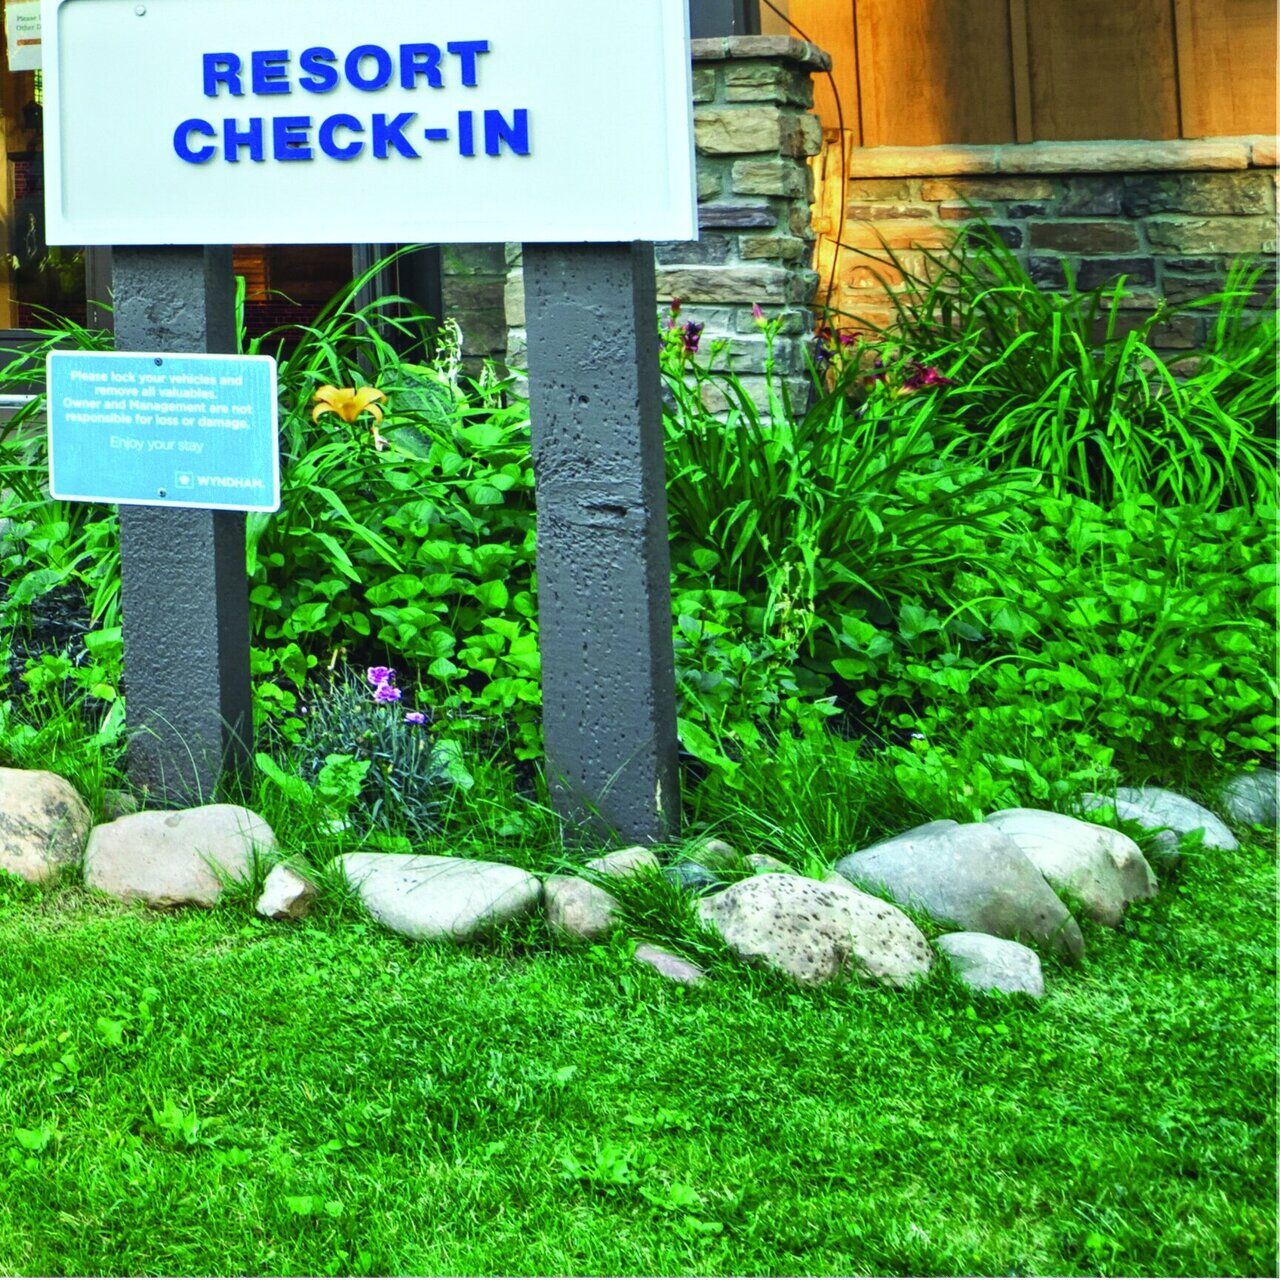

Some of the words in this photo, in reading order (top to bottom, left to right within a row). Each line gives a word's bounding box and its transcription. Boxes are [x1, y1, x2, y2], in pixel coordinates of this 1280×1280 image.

[203, 40, 493, 97] RESORT
[173, 108, 532, 163] CHECK-IN
[71, 370, 108, 381] Please
[110, 371, 136, 382] lock
[139, 374, 165, 384] your
[169, 373, 217, 385] vehicles
[219, 375, 243, 386] and
[95, 387, 138, 396] remove
[141, 386, 156, 397] all
[159, 387, 218, 400] valuables.
[63, 397, 101, 409] Owner
[104, 399, 127, 410] and
[129, 400, 207, 413] Management
[209, 405, 229, 414] are
[231, 404, 252, 415] not
[65, 413, 132, 425] responsible
[135, 414, 153, 424] for
[155, 414, 179, 426] loss
[181, 417, 195, 426] or
[197, 416, 249, 431] damage.
[110, 435, 144, 452] Enjoy
[147, 438, 175, 452] your
[178, 439, 204, 454] stay
